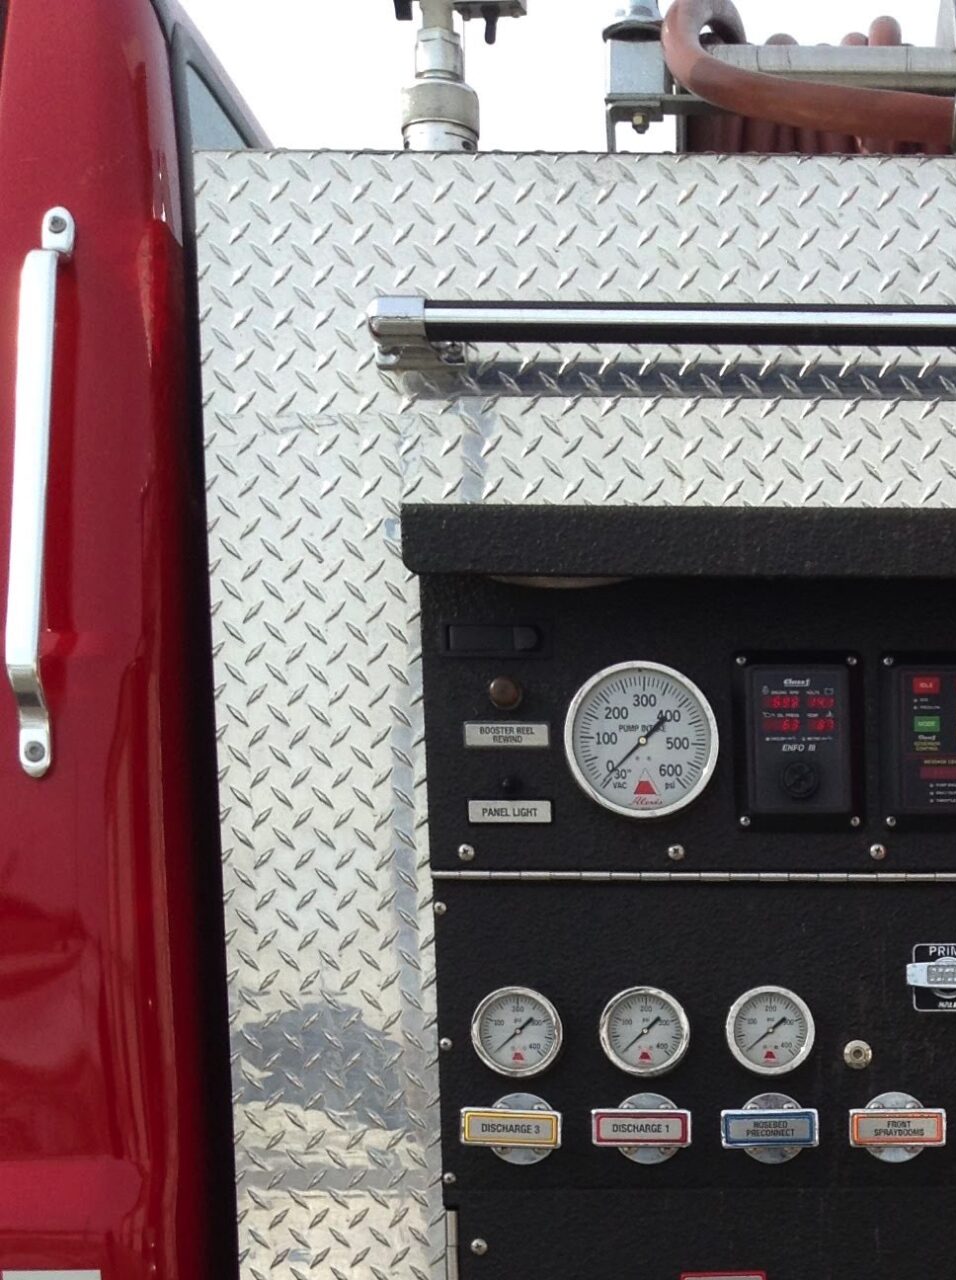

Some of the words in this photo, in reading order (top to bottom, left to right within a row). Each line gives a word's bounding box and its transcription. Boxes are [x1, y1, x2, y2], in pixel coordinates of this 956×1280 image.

[633, 694, 657, 707] 300
[604, 707, 628, 720] 200
[657, 710, 681, 722] 400
[596, 732, 618, 745] 100
[666, 737, 689, 750] 500
[659, 764, 682, 777] 600
[482, 808, 510, 816] PANEL
[512, 808, 537, 816] LIGHT
[481, 1123, 533, 1134] DISCHARGE
[534, 1125, 540, 1134] 3
[612, 1124, 663, 1134] DISCHARGE
[665, 1124, 670, 1133] 1
[746, 1129, 795, 1137] PRECONNECT
[874, 1128, 924, 1137] SPRAYBOOMS
